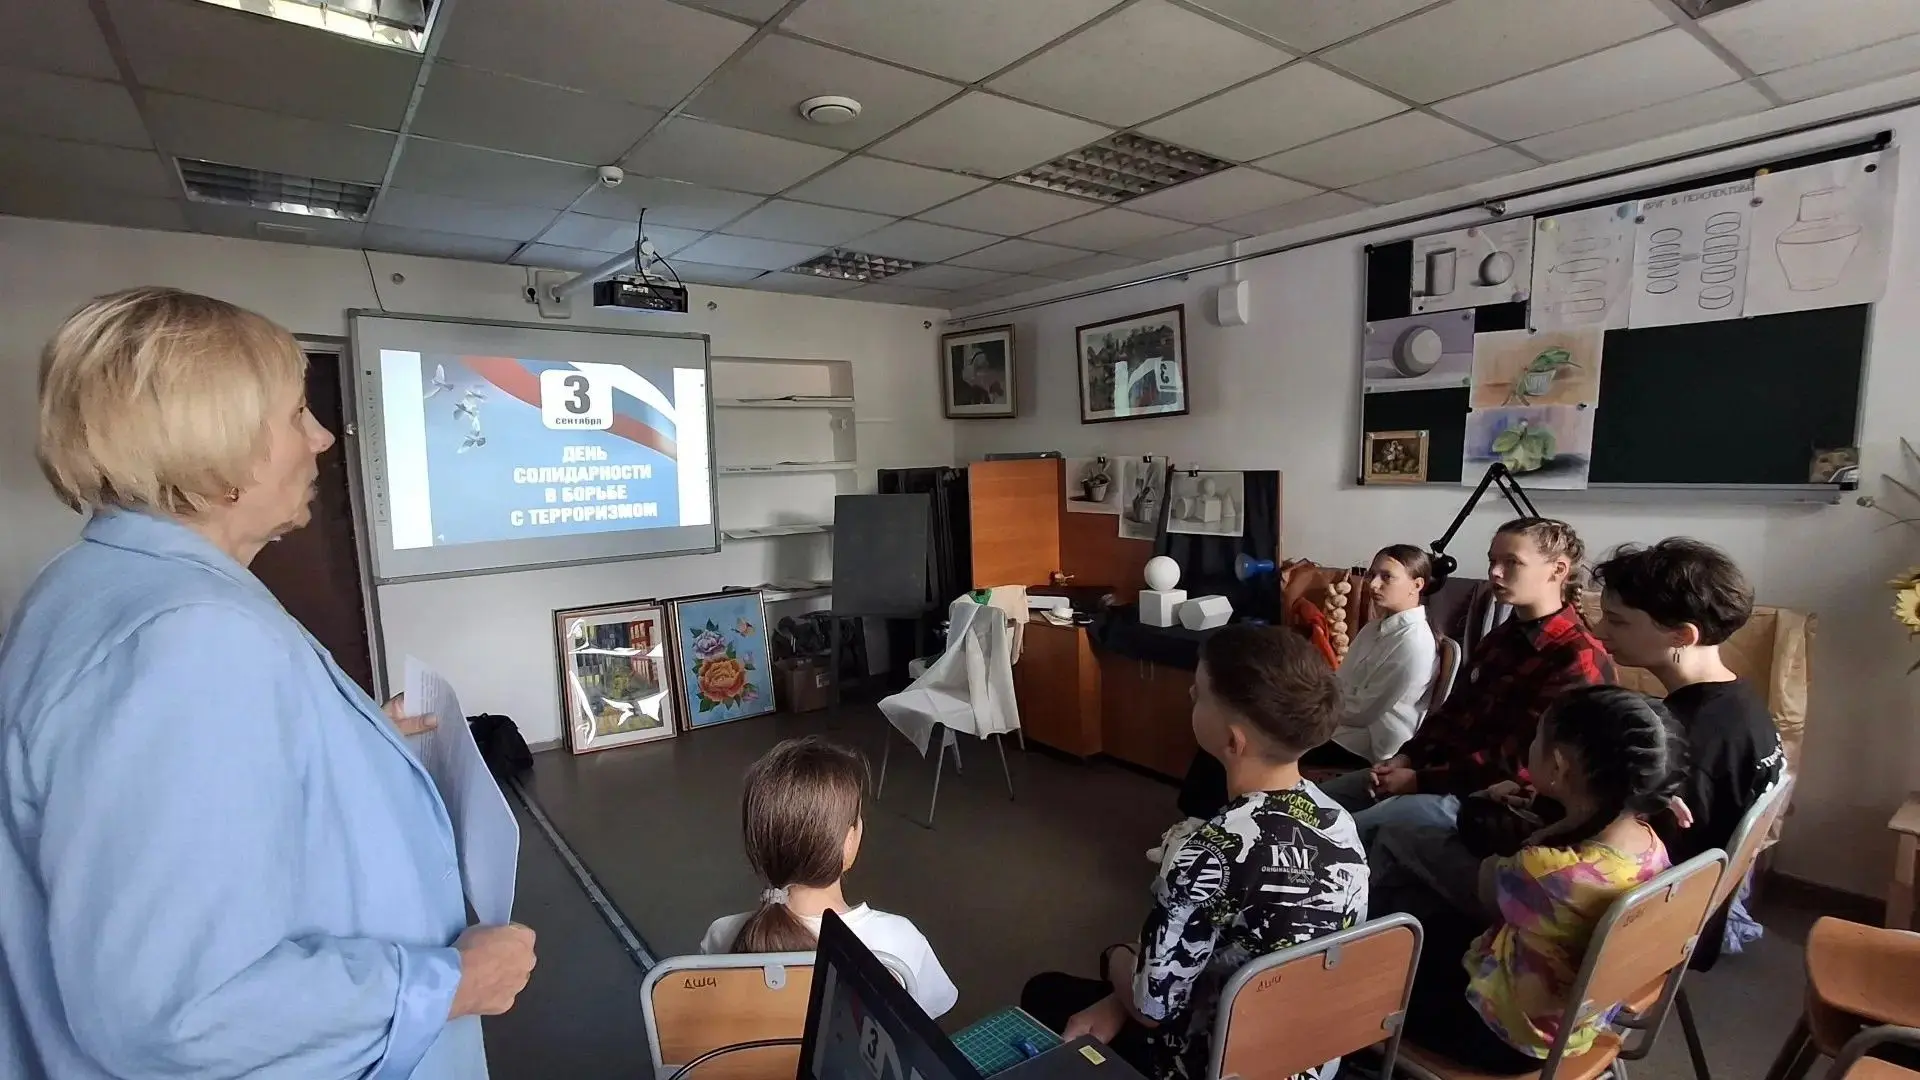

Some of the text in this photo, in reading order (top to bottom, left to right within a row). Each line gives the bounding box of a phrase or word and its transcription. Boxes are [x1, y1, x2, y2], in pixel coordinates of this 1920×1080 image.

[564, 375, 590, 414] 3
[555, 416, 602, 427] сентября
[562, 445, 608, 463] ДЕНЬ
[513, 463, 652, 484] СОЛИДАРНОСТИ
[544, 484, 628, 503] В БОРЬБЕ
[510, 502, 658, 526] С ТЕРРОРИЗМОМ
